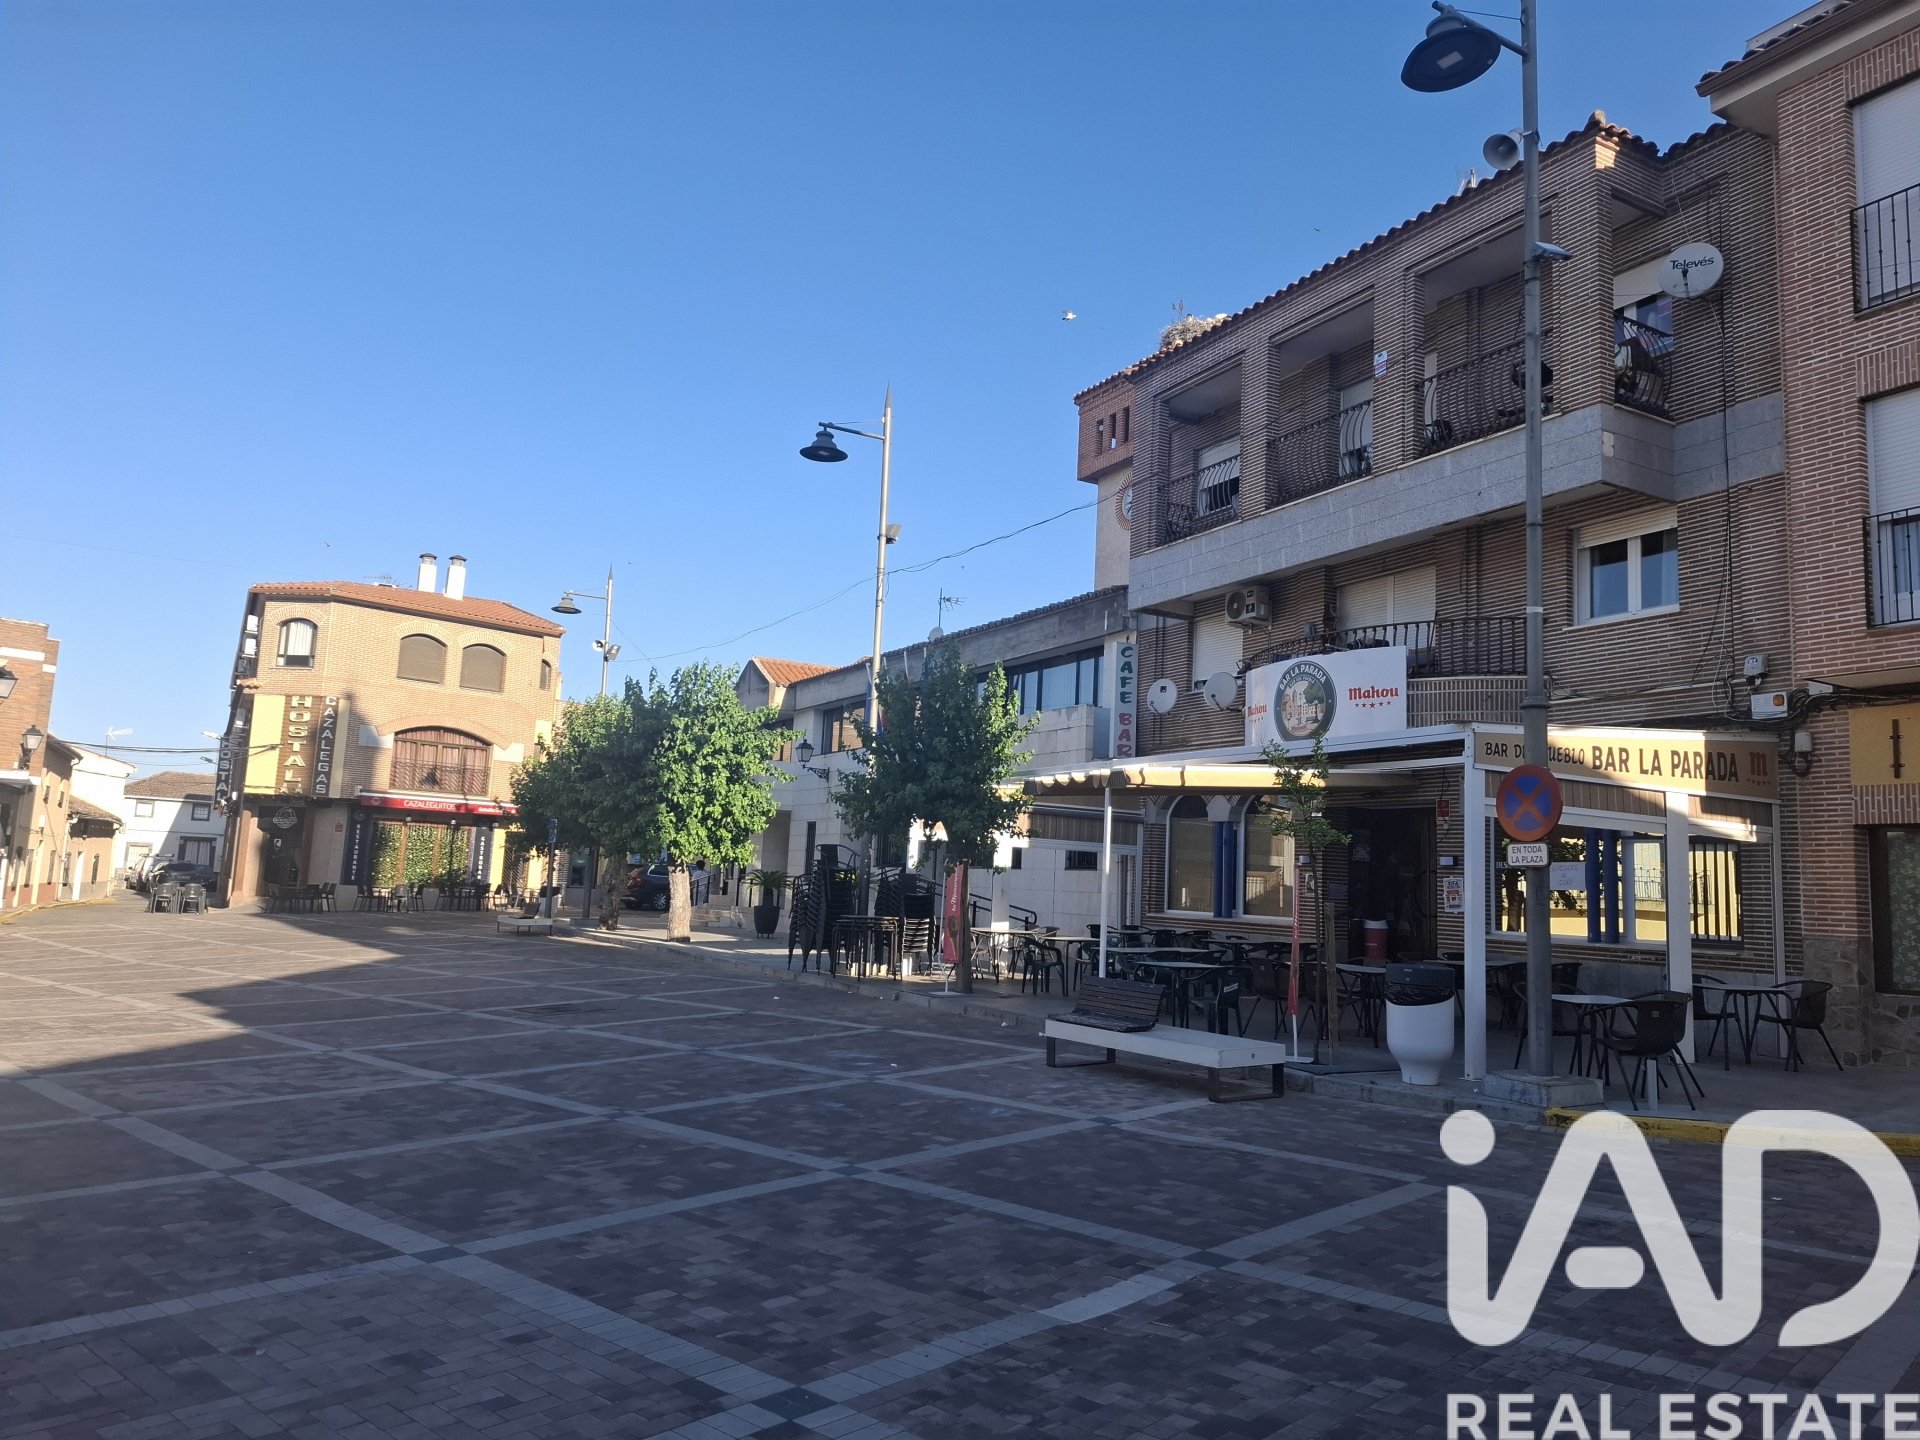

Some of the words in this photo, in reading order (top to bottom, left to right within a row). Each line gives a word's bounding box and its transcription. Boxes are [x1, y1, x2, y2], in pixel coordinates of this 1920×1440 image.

[1670, 256, 1715, 270] Televés
[1119, 645, 1134, 705] CAFE
[1290, 666, 1300, 677] LA
[1300, 664, 1327, 684] PARADA
[1348, 685, 1400, 701] Mahou
[283, 695, 313, 782] HOSTAL
[315, 696, 337, 794] CAZALEGAS
[1116, 712, 1134, 759] BAR
[1485, 742, 1508, 758] BAR
[1547, 746, 1585, 765] UEBLO
[1591, 745, 1630, 773] BAR
[1639, 748, 1663, 776] LA
[1670, 750, 1739, 783] PARADA
[403, 799, 457, 811] CAZALEGUITOS
[1511, 855, 1520, 864] LA
[1521, 855, 1544, 864] PLAZA
[1512, 846, 1521, 854] EN
